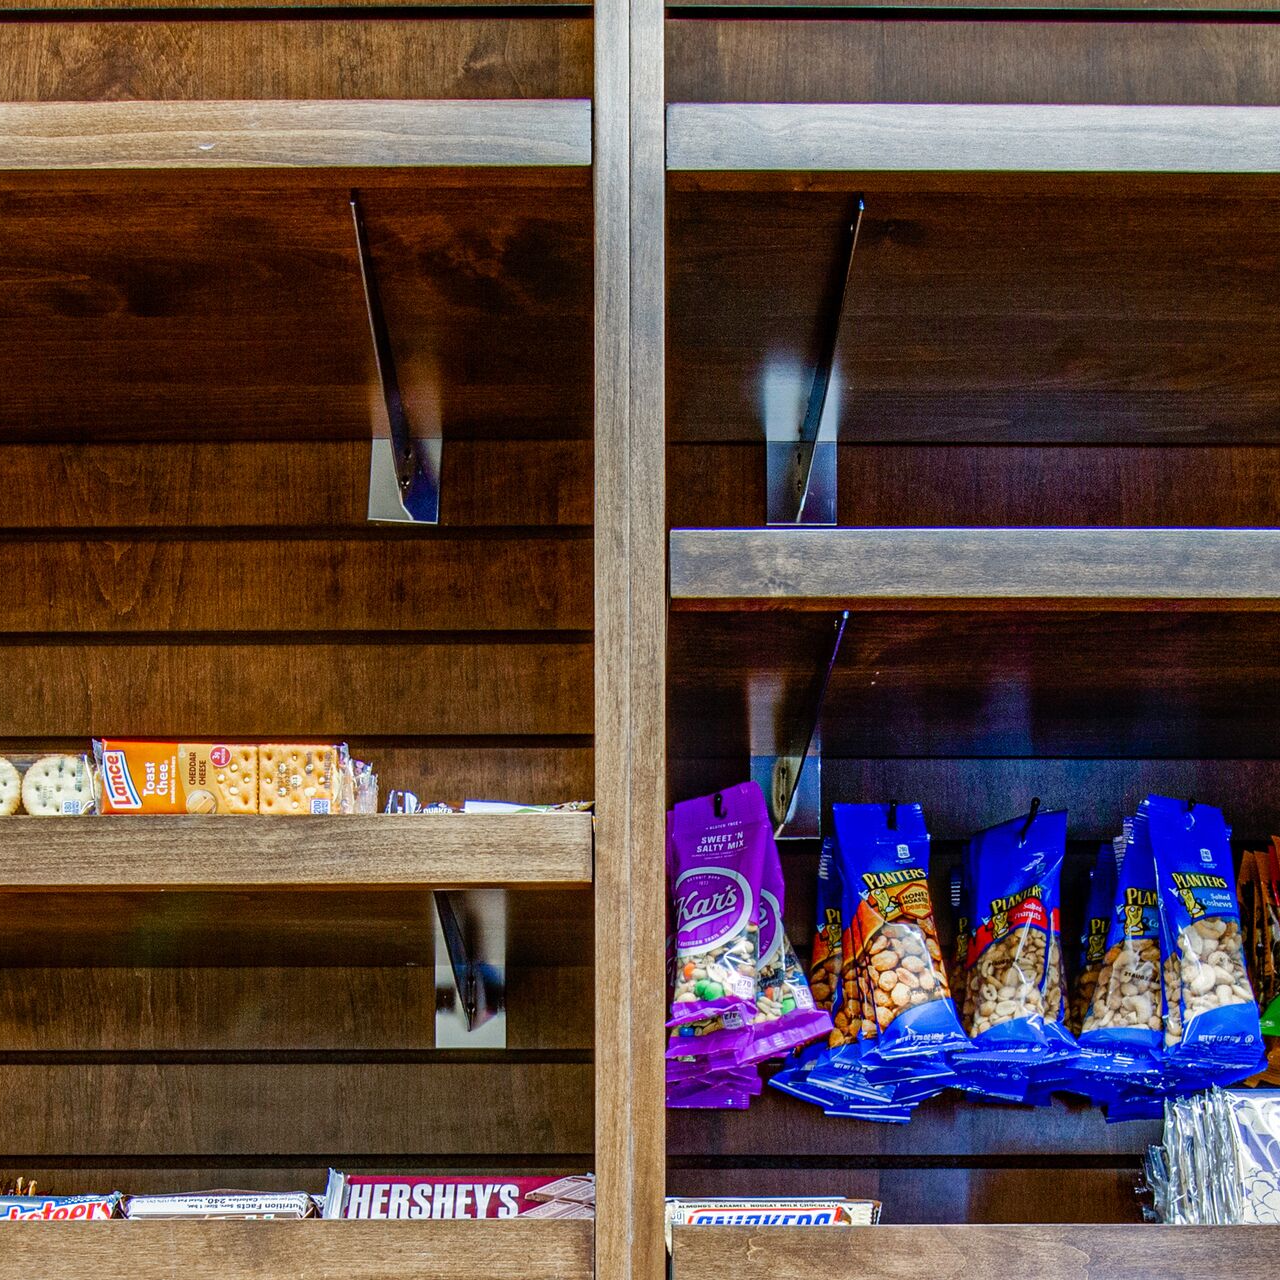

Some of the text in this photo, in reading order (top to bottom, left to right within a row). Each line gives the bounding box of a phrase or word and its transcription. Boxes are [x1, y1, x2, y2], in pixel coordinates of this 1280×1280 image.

[110, 753, 133, 807] Lance
[142, 761, 156, 797] Toast
[156, 761, 169, 796] Chee
[188, 751, 197, 786] CHEDDAR
[199, 759, 207, 786] CHEESE
[696, 839, 745, 854] SALTY MIX
[700, 833, 730, 845] SWEET
[862, 867, 927, 889] PLANTERS
[1171, 872, 1228, 889] PLANTERS
[990, 884, 1045, 914] PLANTERS
[1210, 892, 1231, 902] Salted
[263, 1203, 304, 1212] Nutrition
[347, 1183, 520, 1219] HERSHEY'S
